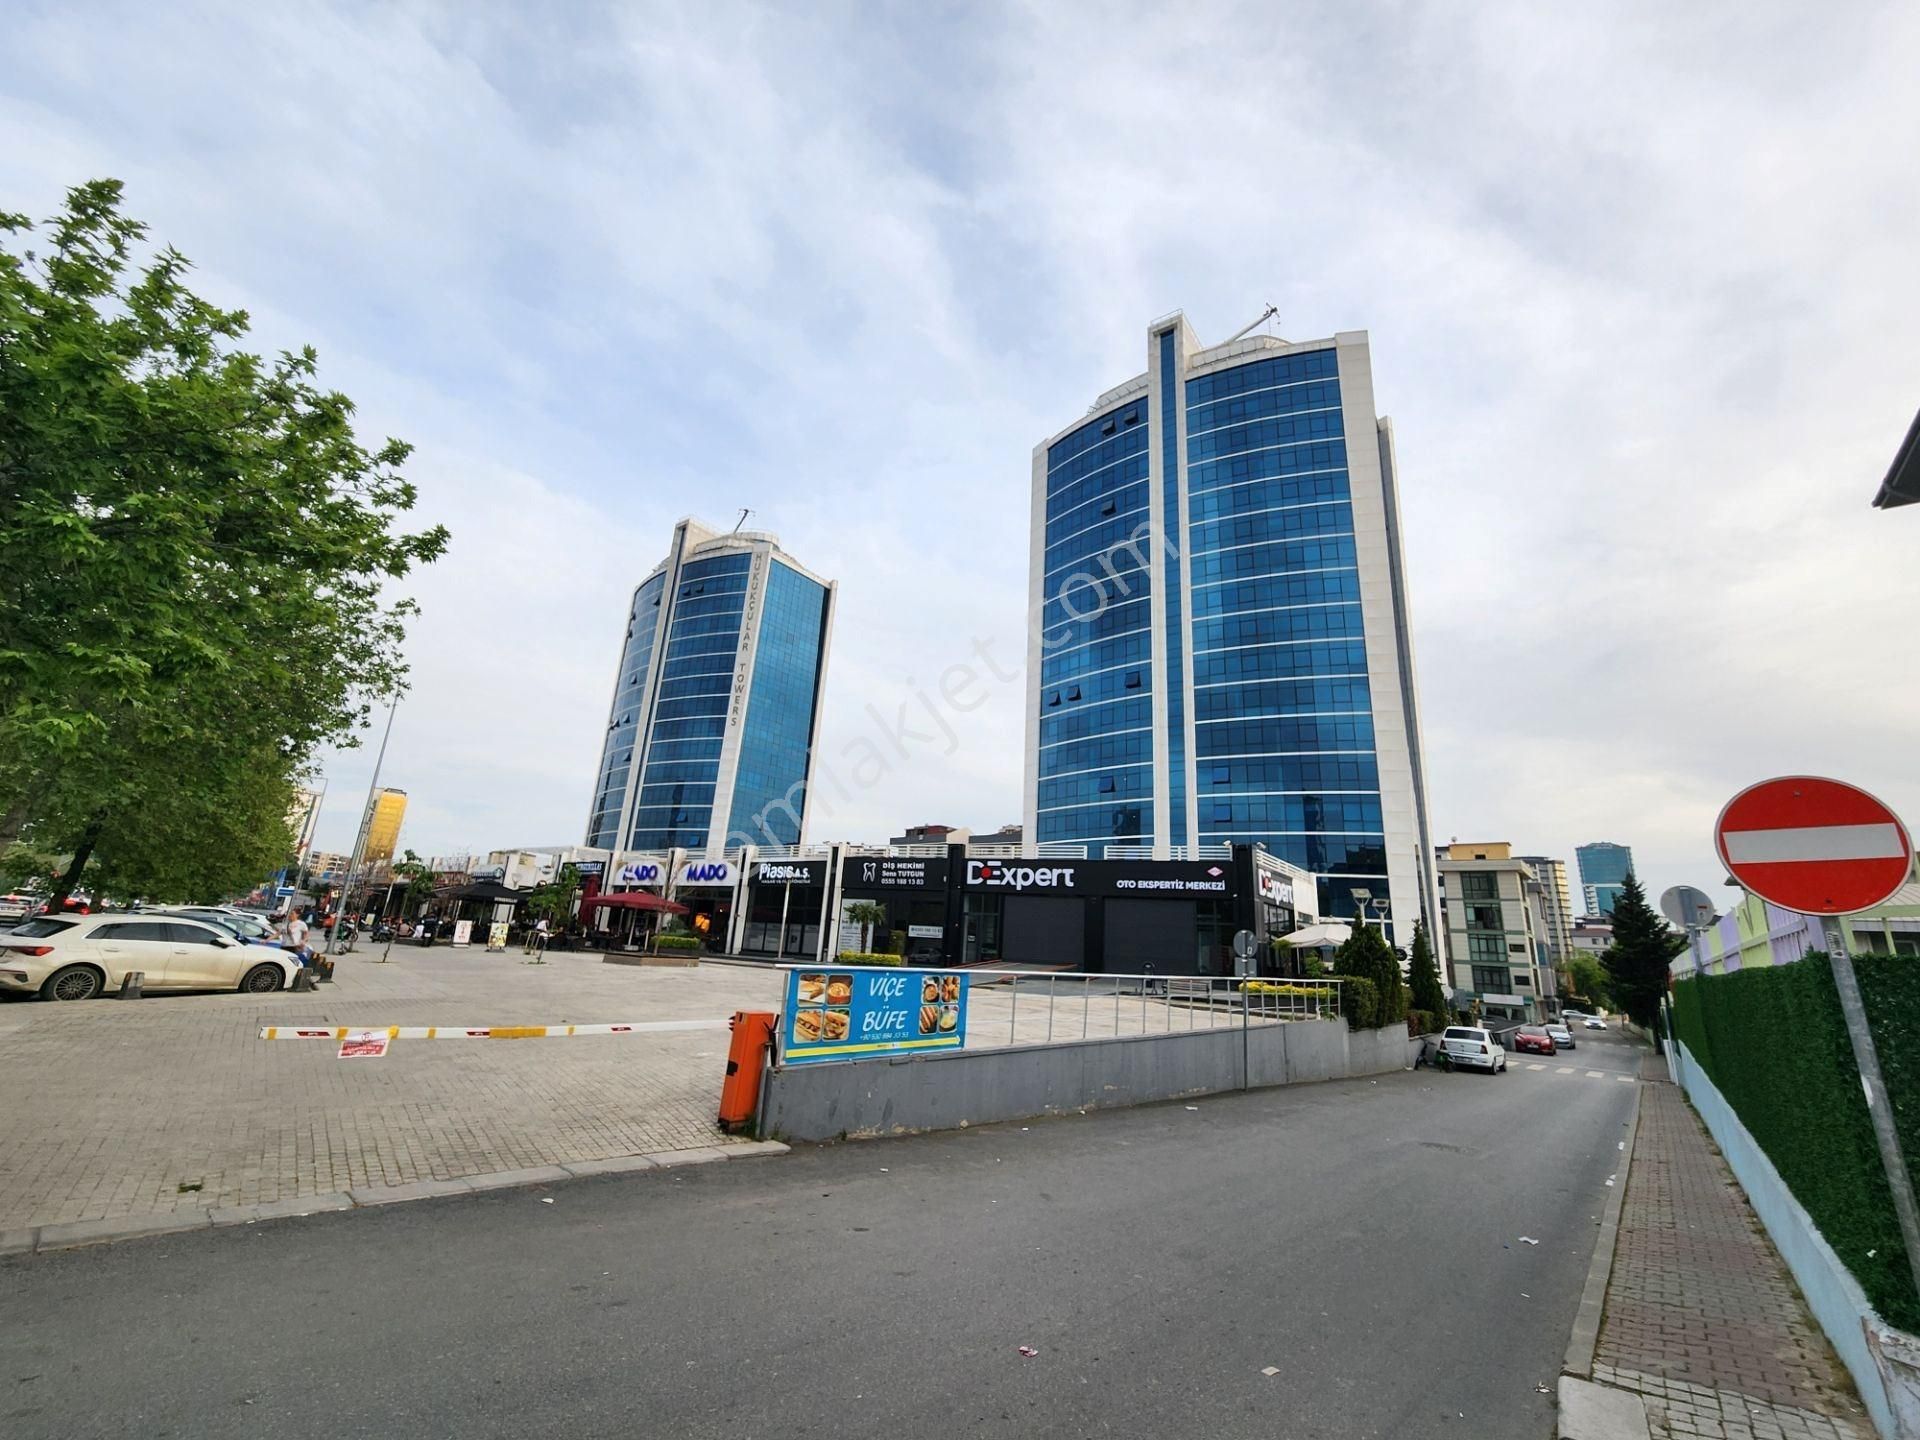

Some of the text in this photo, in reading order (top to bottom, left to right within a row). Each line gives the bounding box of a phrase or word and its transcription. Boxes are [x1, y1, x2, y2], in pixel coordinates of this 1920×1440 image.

[730, 552, 762, 727] HUKUKÇULAR TOWERS
[686, 863, 728, 882] MADO
[896, 861, 925, 870] HEKİMİ
[1116, 879, 1226, 891] OTO EKSPERTİZ MERKEZİ
[870, 972, 908, 1002] VİÇE
[862, 1005, 909, 1032] BÜFE
